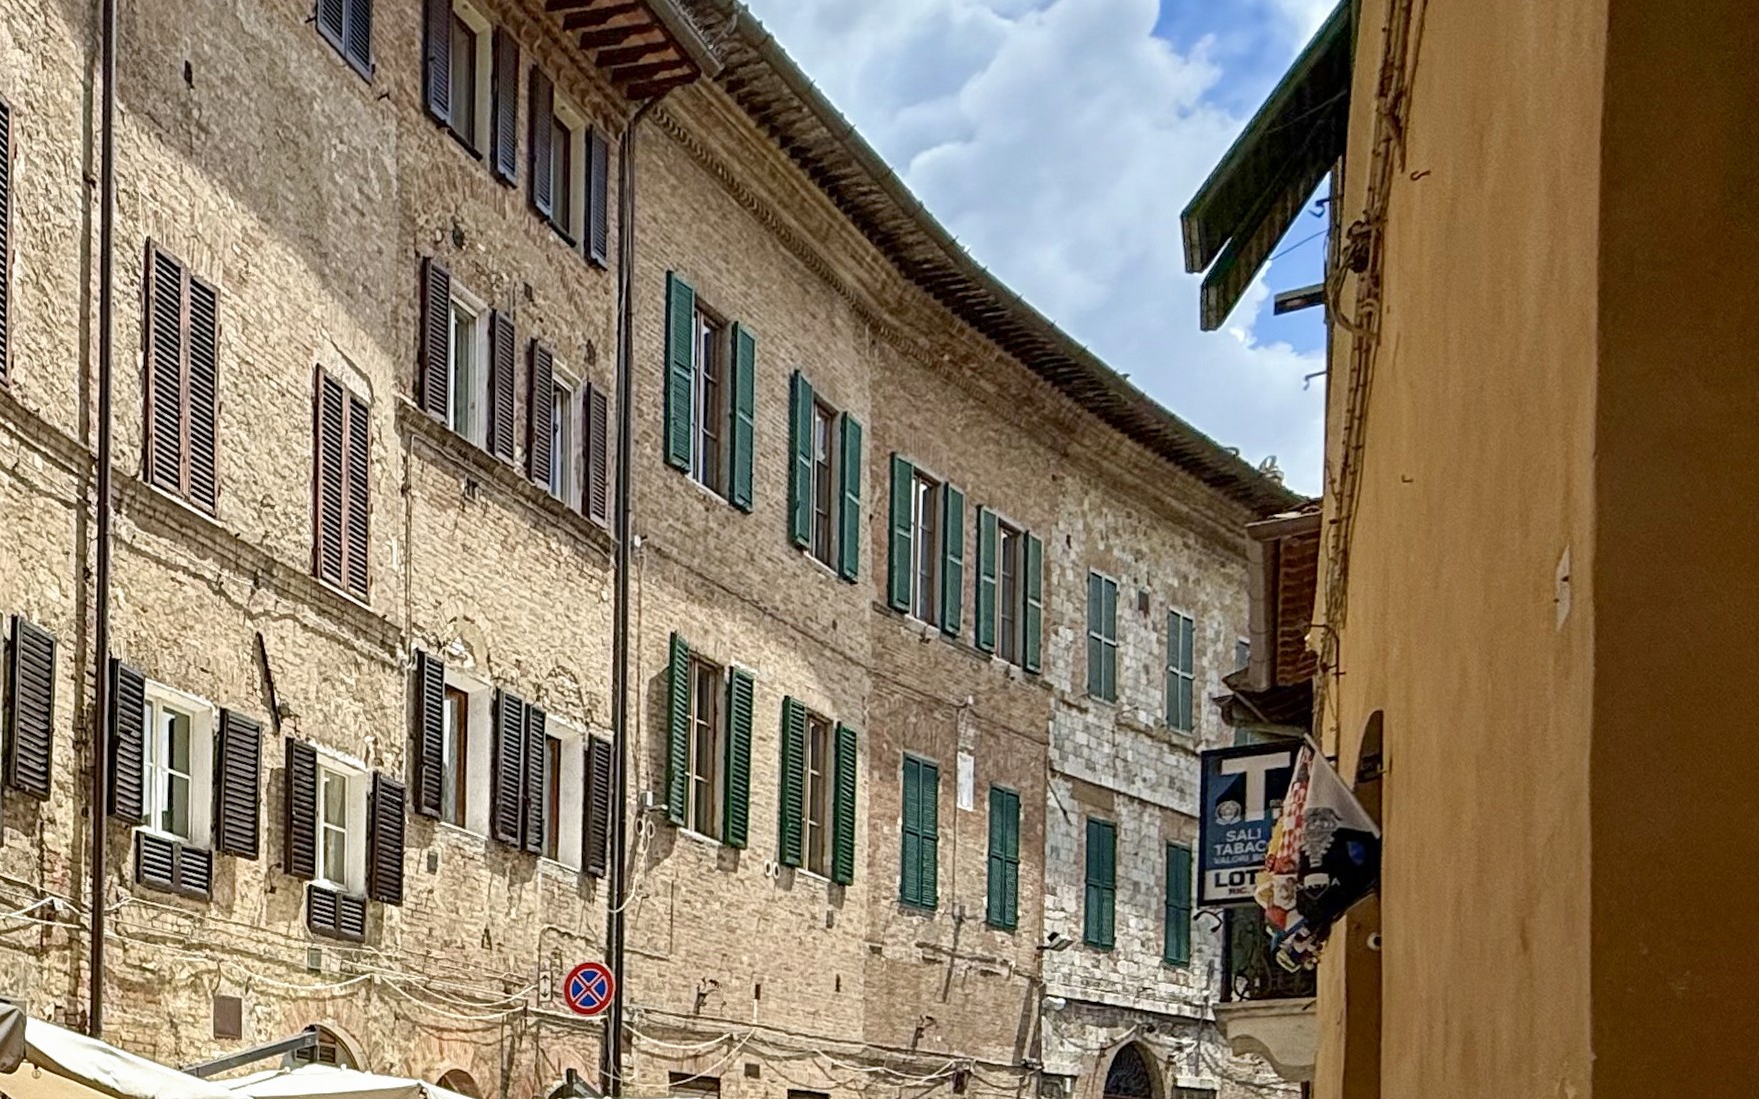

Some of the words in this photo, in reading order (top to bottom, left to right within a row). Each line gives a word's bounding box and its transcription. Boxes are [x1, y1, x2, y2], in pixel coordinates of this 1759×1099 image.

[1221, 752, 1291, 822] T
[1226, 828, 1261, 841] SALI
[1214, 841, 1266, 855] TABAC
[1215, 869, 1259, 887] LOT
